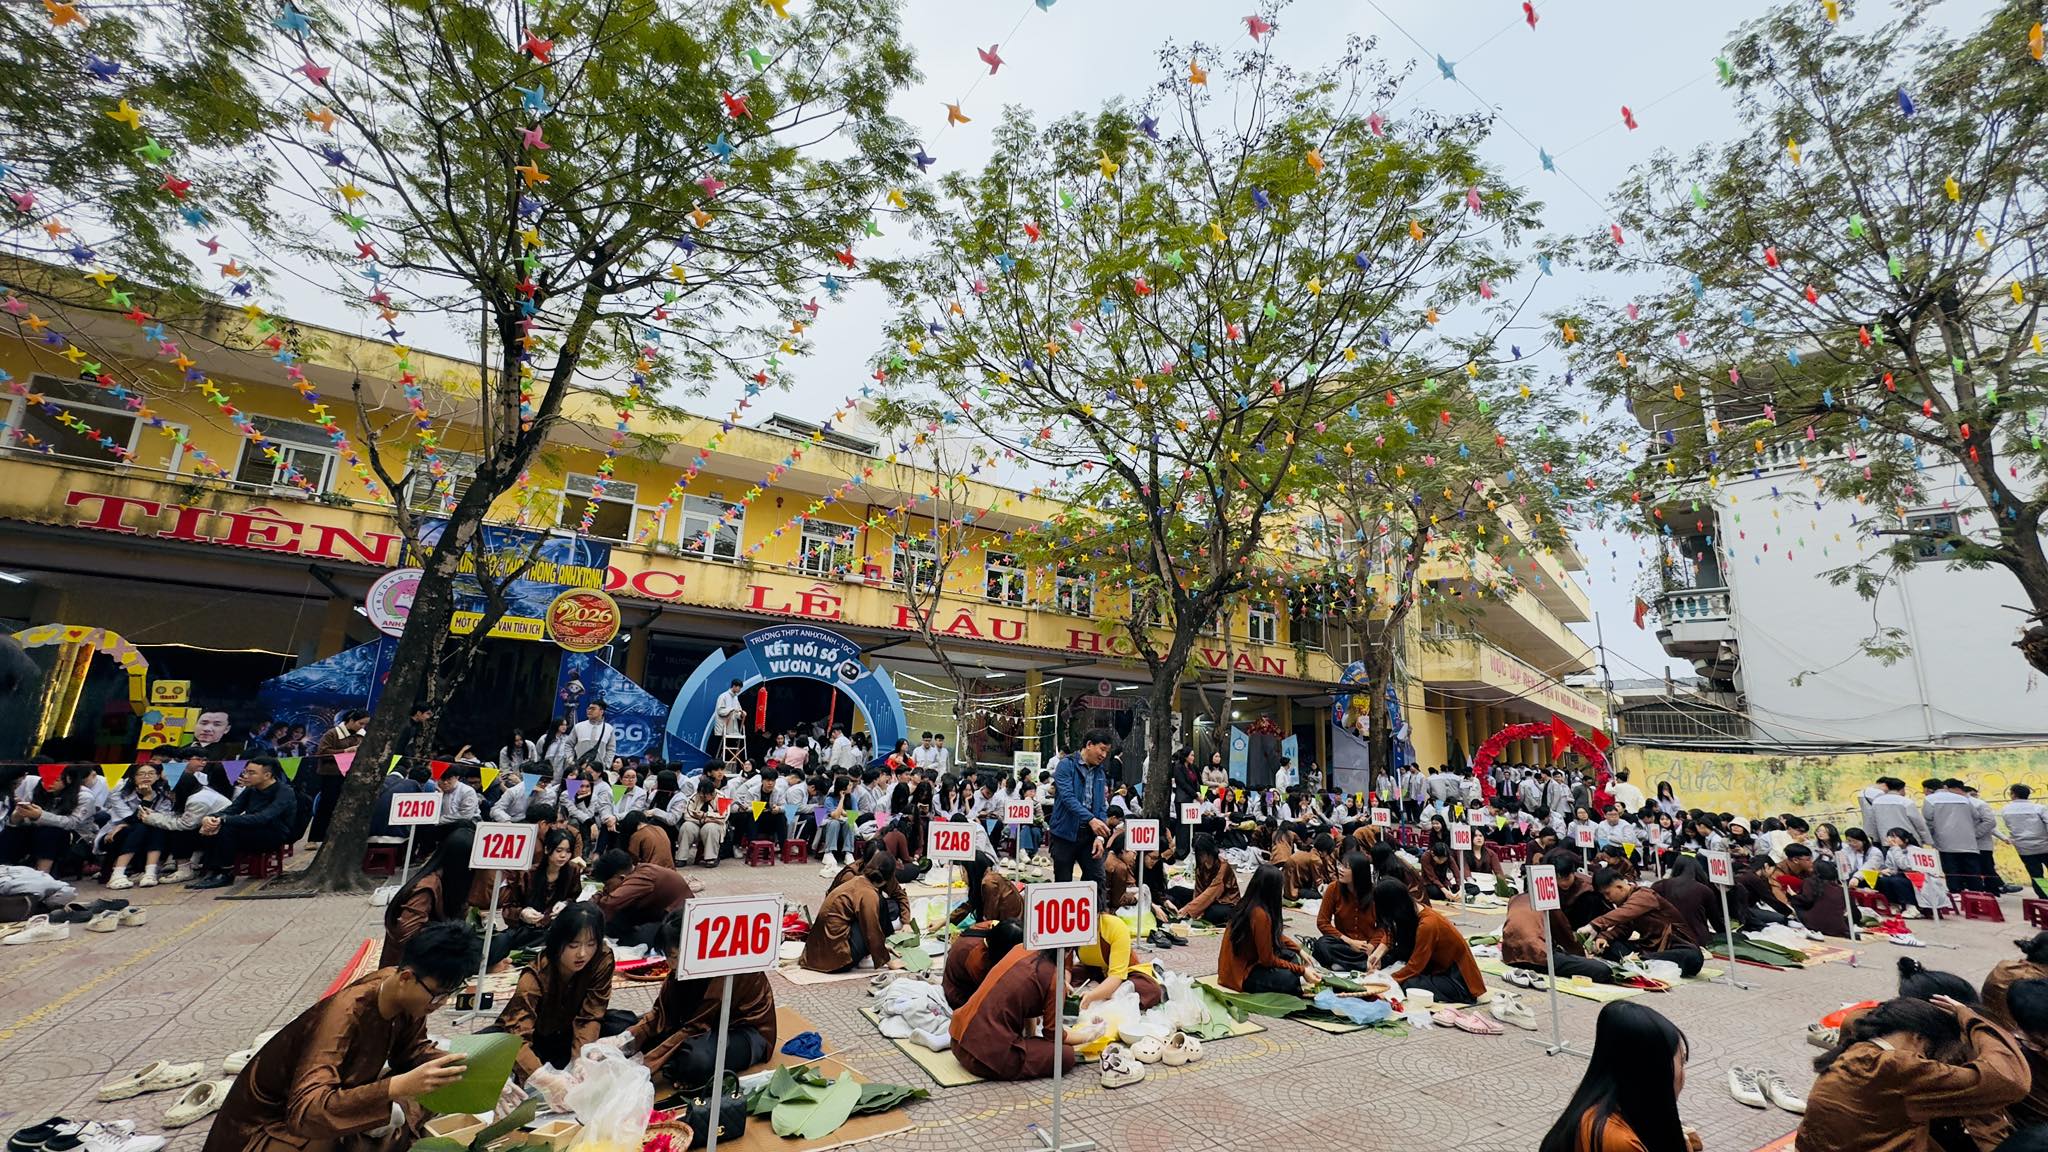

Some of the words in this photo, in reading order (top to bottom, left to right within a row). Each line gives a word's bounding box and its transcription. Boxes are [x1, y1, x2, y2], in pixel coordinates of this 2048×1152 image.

[64, 489, 403, 565] TIÊN
[744, 582, 842, 620] LỄ
[1199, 647, 1288, 675] VĂN
[556, 599, 613, 623] 2026
[781, 629, 799, 637] THPT
[800, 629, 837, 646] ANHXTANH
[764, 639, 791, 657] KẾT
[793, 641, 819, 658] NỐI
[819, 647, 840, 663] SỐ
[769, 658, 811, 673] VƯƠN
[812, 662, 831, 679] XA
[613, 723, 643, 741] 5G
[1284, 747, 1296, 758] AI
[397, 799, 435, 818] 12A10
[1008, 807, 1030, 819] 12A9
[933, 830, 970, 852] 12A8
[1130, 826, 1156, 844] 10C7
[482, 833, 526, 860] 12A7
[1710, 858, 1727, 877] 10C4
[1912, 853, 1936, 869] 11B5
[1535, 876, 1557, 901] 10C5
[1034, 897, 1091, 936] 10C6
[694, 912, 772, 960] 12A6
